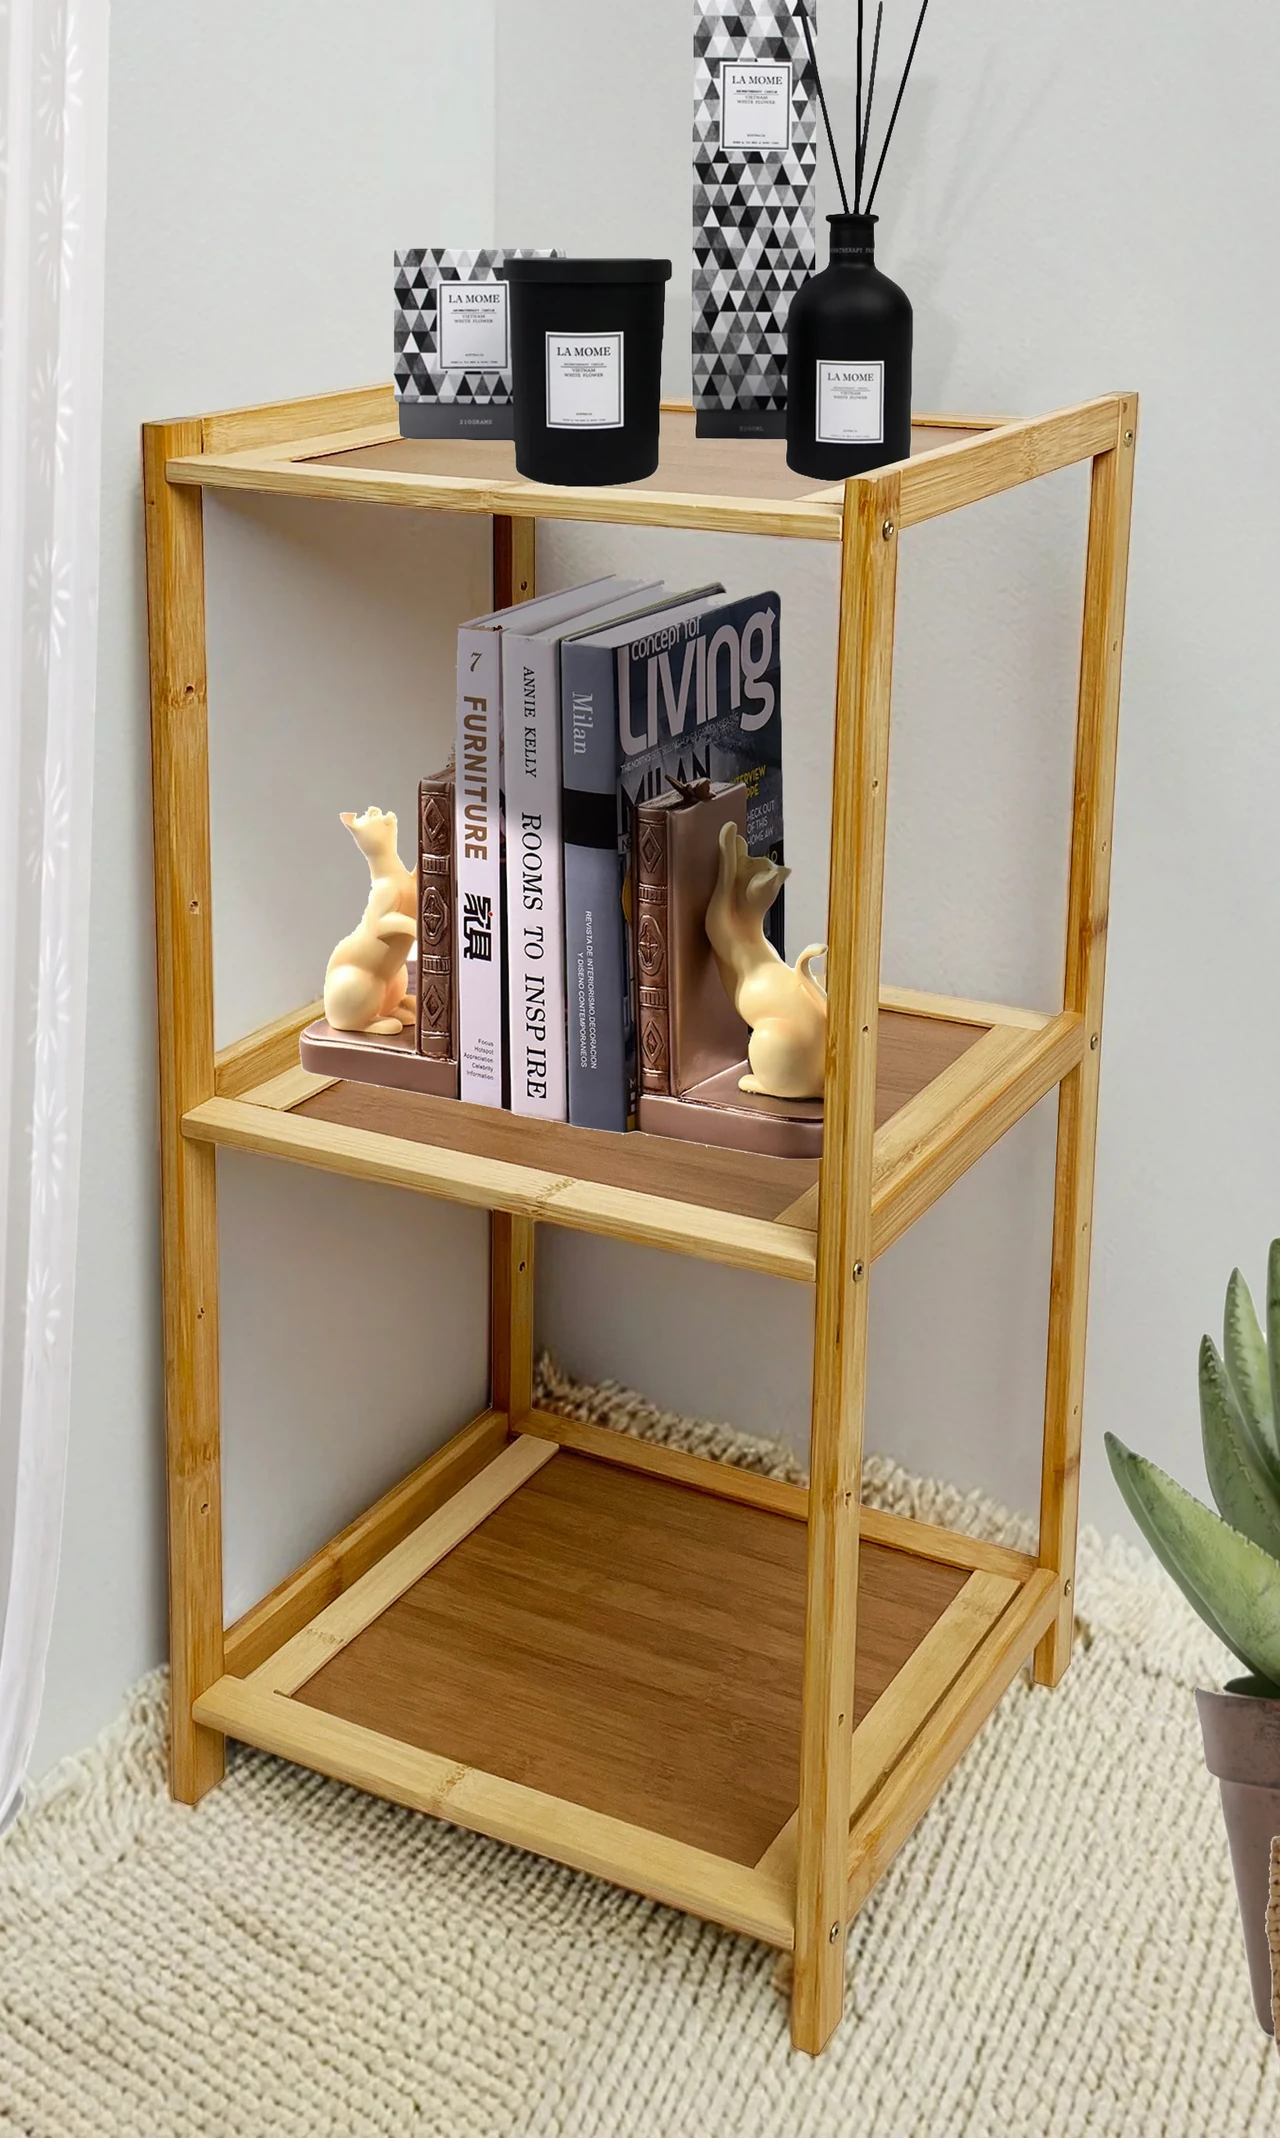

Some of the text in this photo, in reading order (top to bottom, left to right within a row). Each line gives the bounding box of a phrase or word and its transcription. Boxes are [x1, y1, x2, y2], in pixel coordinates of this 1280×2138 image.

[732, 75, 783, 85] LA MOME
[448, 294, 500, 304] LA MOME
[556, 346, 611, 356] LA MOME
[827, 372, 874, 382] LA MOME
[469, 652, 482, 672] 7
[523, 666, 537, 778] ANNIE KELLY
[572, 691, 593, 755] Milan
[463, 696, 488, 861] FURNITURE
[762, 800, 775, 814] OUT
[521, 811, 542, 911] ROOMS
[463, 891, 492, 962] 家具
[524, 924, 544, 960] TO
[586, 946, 593, 957] DE
[478, 1038, 494, 1047] Focus
[474, 1046, 494, 1055] Hotspot
[464, 1052, 493, 1063] Appreciation
[472, 1062, 493, 1073] Celebrity
[466, 1070, 494, 1080] Information
